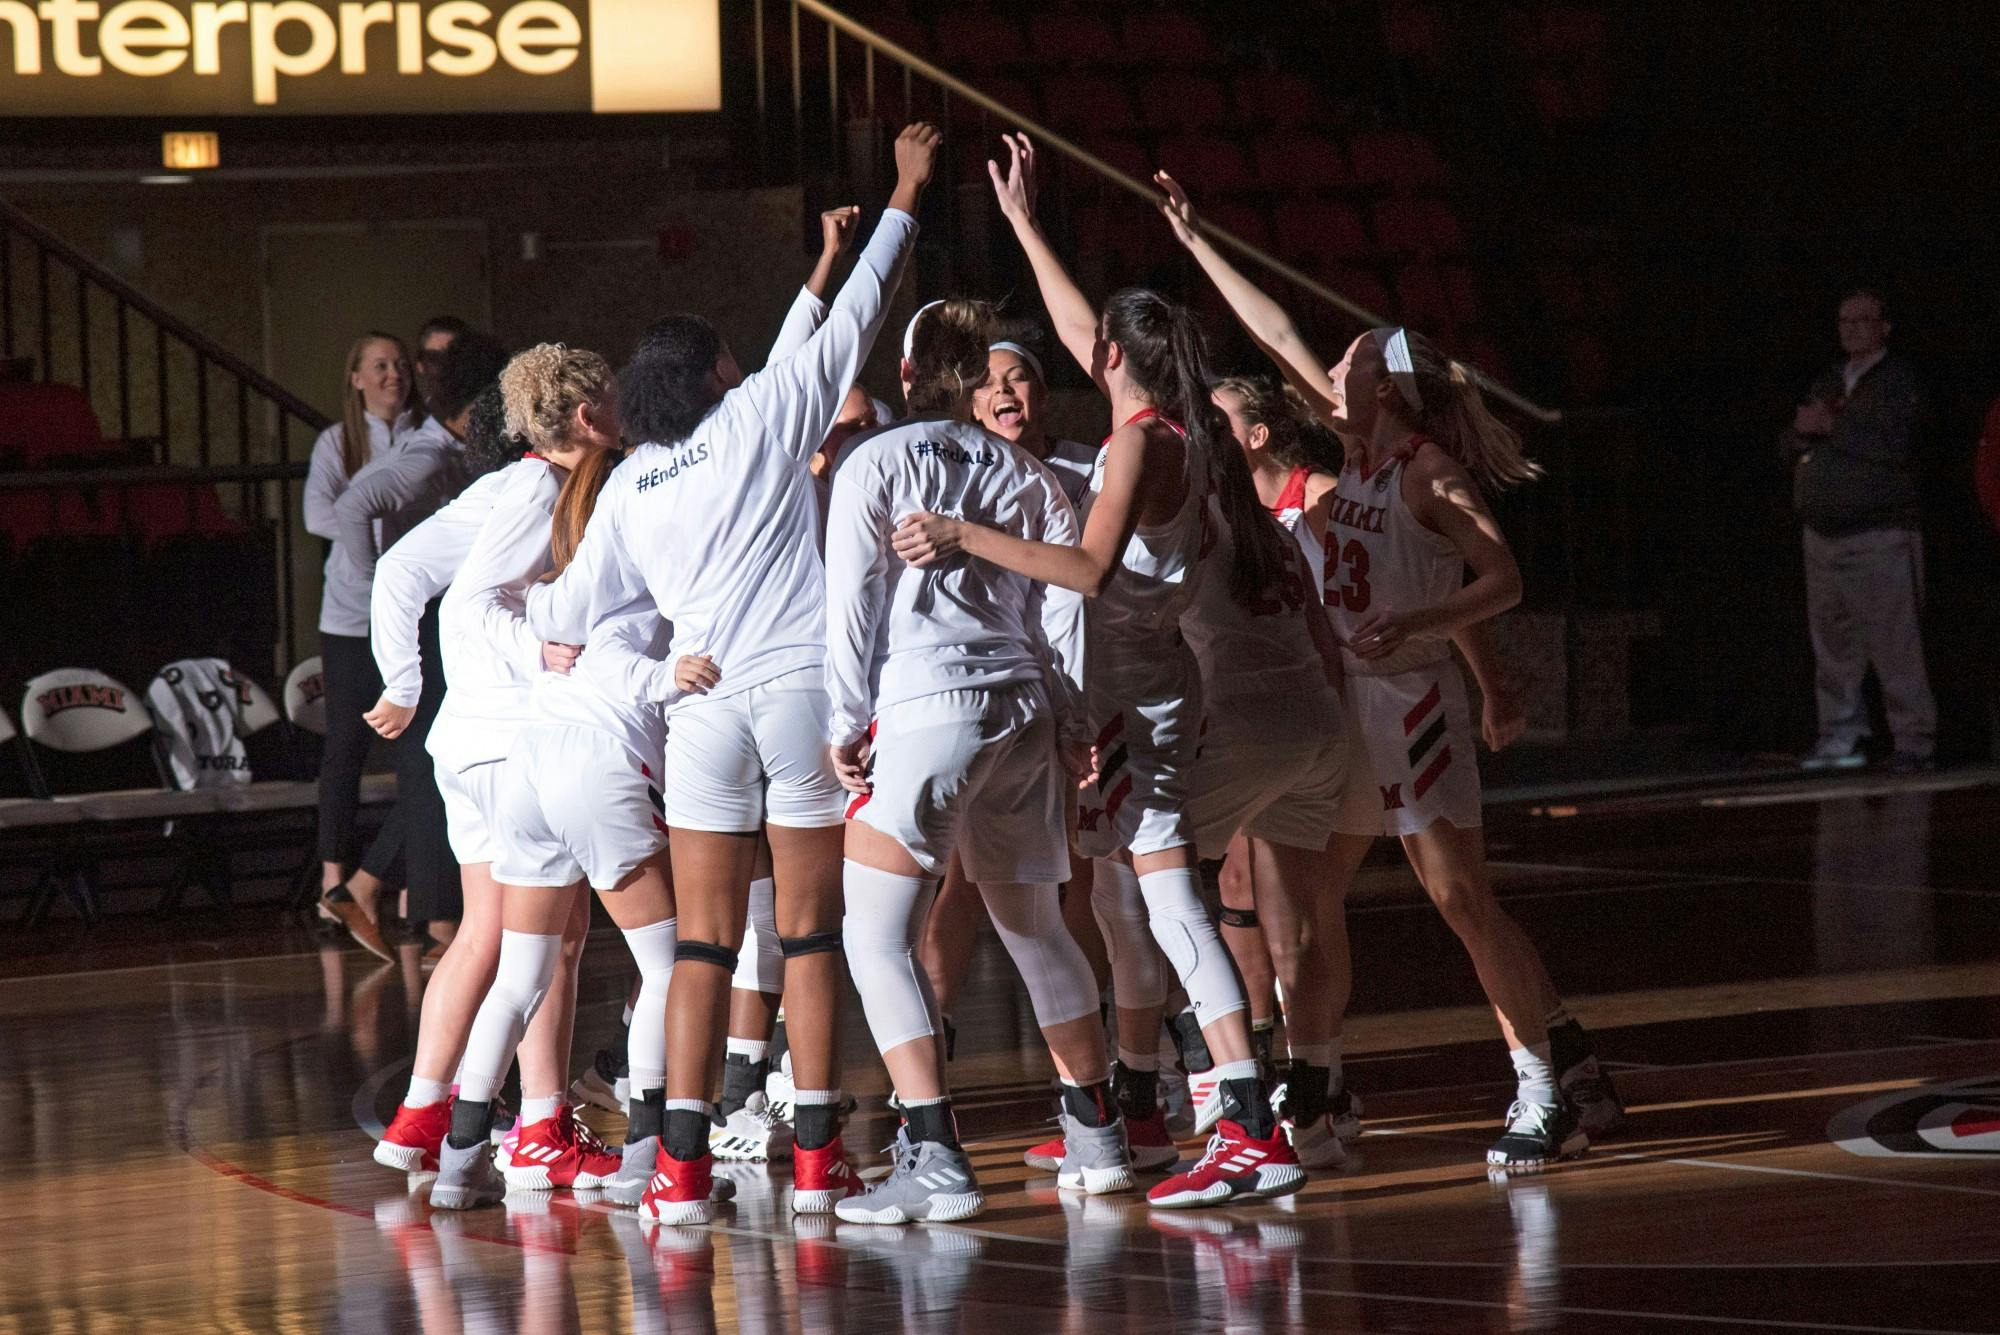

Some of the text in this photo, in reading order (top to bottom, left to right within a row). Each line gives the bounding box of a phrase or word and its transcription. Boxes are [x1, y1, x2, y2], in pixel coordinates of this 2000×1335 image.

[636, 443, 708, 493] #EndALS
[915, 440, 995, 467] #EndALS
[1324, 531, 1371, 612] 23
[37, 684, 126, 717] MIAMI
